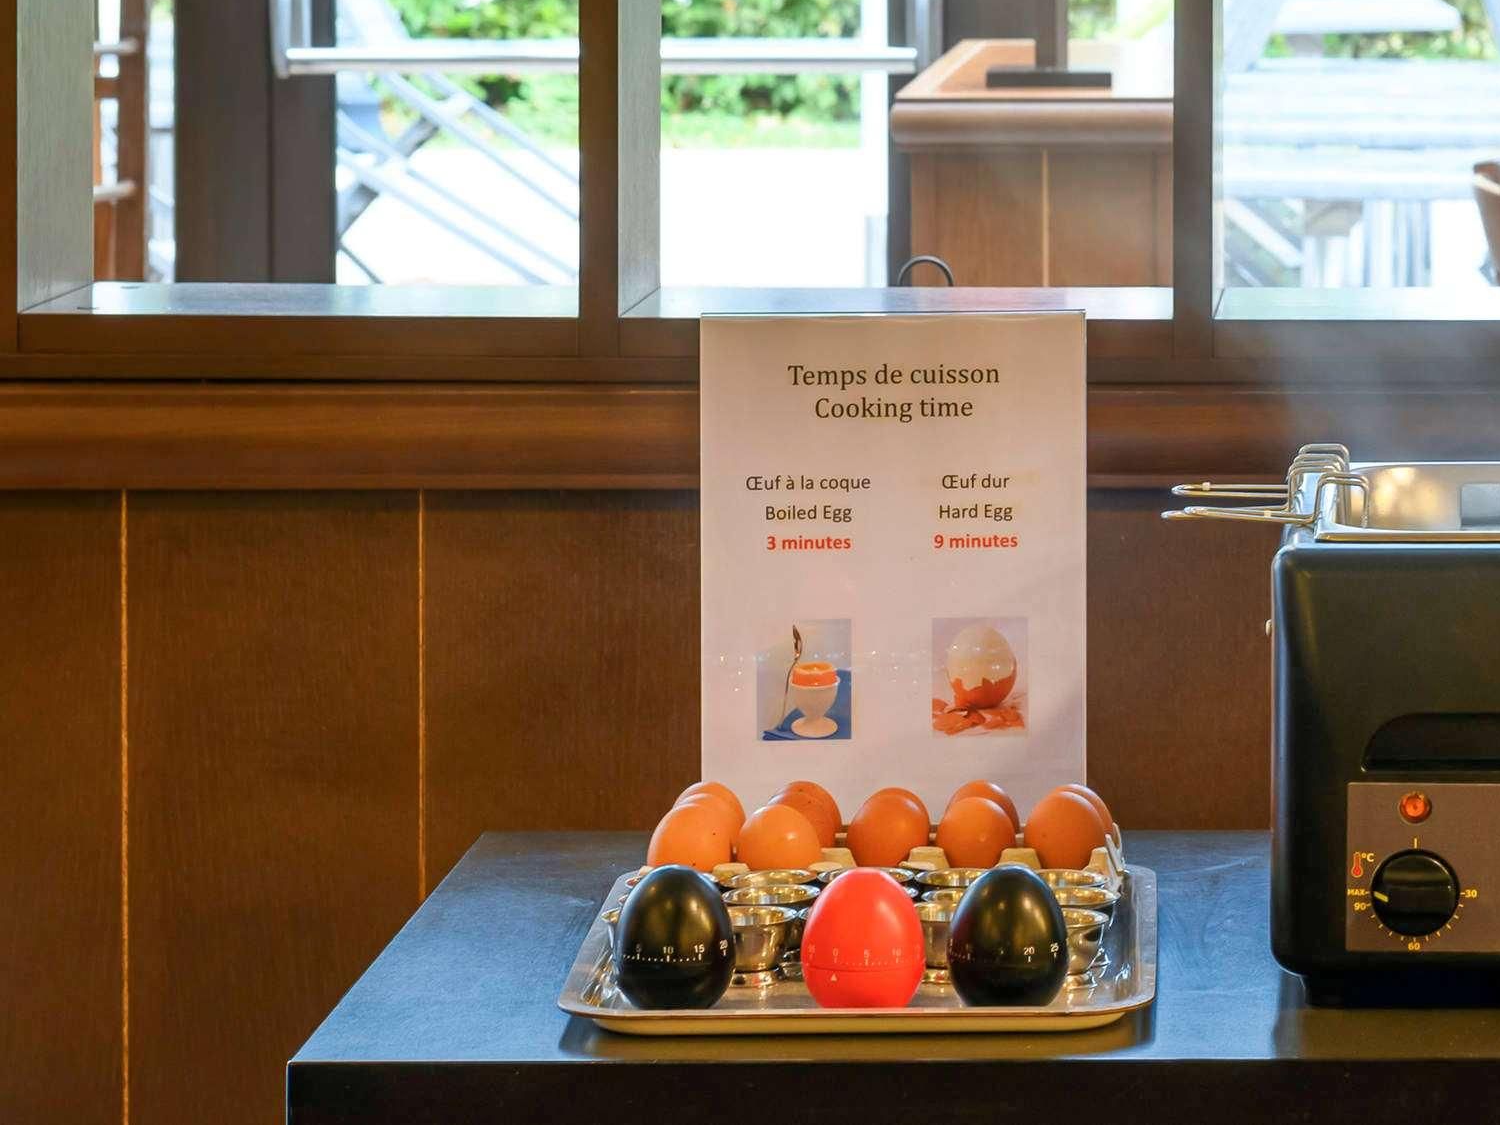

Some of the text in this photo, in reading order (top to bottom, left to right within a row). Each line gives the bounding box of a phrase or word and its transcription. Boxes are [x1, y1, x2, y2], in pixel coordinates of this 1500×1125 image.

[787, 363, 1000, 391] Temps de cuisson
[815, 396, 973, 424] Cooking time
[745, 474, 871, 493] Œuf à la coque
[941, 473, 1010, 490] Œuf dur
[765, 504, 853, 524] Boiled Egg
[939, 503, 1013, 523] Hard Egg
[766, 535, 852, 551] 3 minutes
[933, 533, 1018, 550] 9 minutes
[1465, 889, 1478, 898] 30
[1354, 903, 1367, 911] 90
[662, 945, 674, 955] 10
[694, 943, 706, 954] 15
[1023, 942, 1060, 956] 20 25
[1407, 942, 1421, 951] 60
